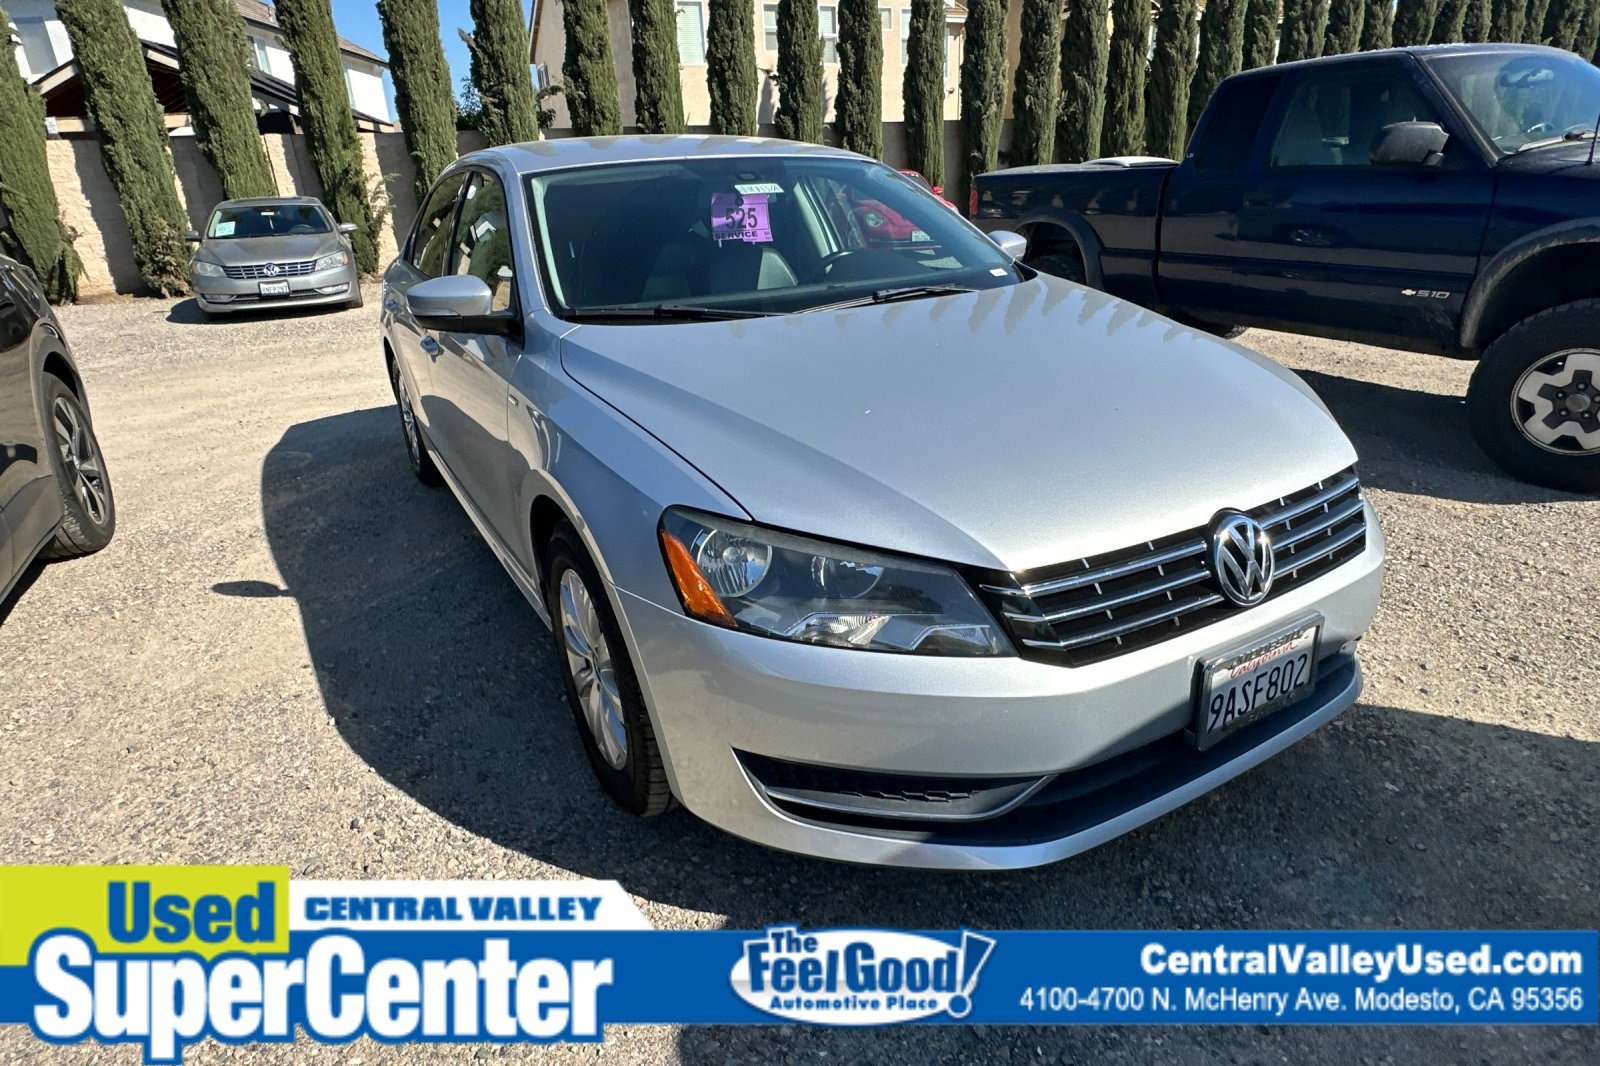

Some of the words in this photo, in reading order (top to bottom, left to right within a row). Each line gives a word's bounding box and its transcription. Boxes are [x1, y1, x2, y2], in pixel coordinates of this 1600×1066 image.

[725, 207, 758, 229] 525
[1416, 289, 1450, 299] S10
[1207, 653, 1308, 733] 9ASF802
